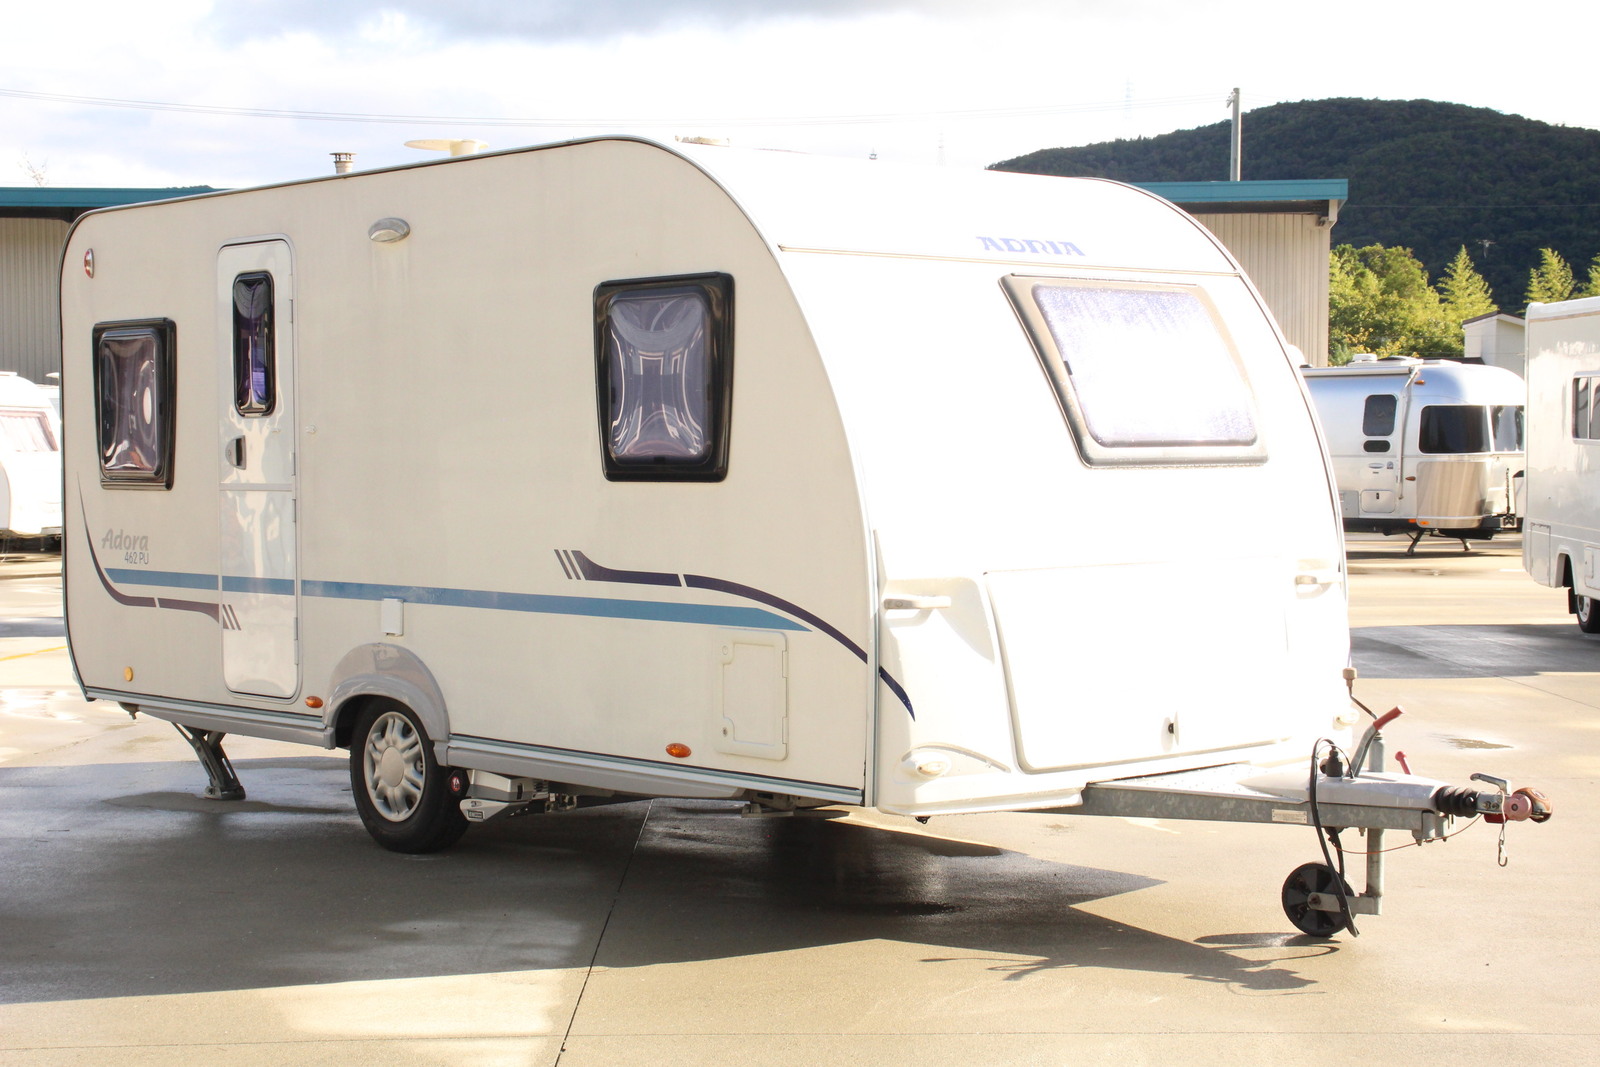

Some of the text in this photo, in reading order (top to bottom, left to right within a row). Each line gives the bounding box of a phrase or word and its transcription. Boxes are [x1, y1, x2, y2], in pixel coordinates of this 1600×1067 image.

[976, 236, 1086, 256] ADRIA
[102, 528, 148, 551] Adora
[124, 552, 149, 565] 462 PU
